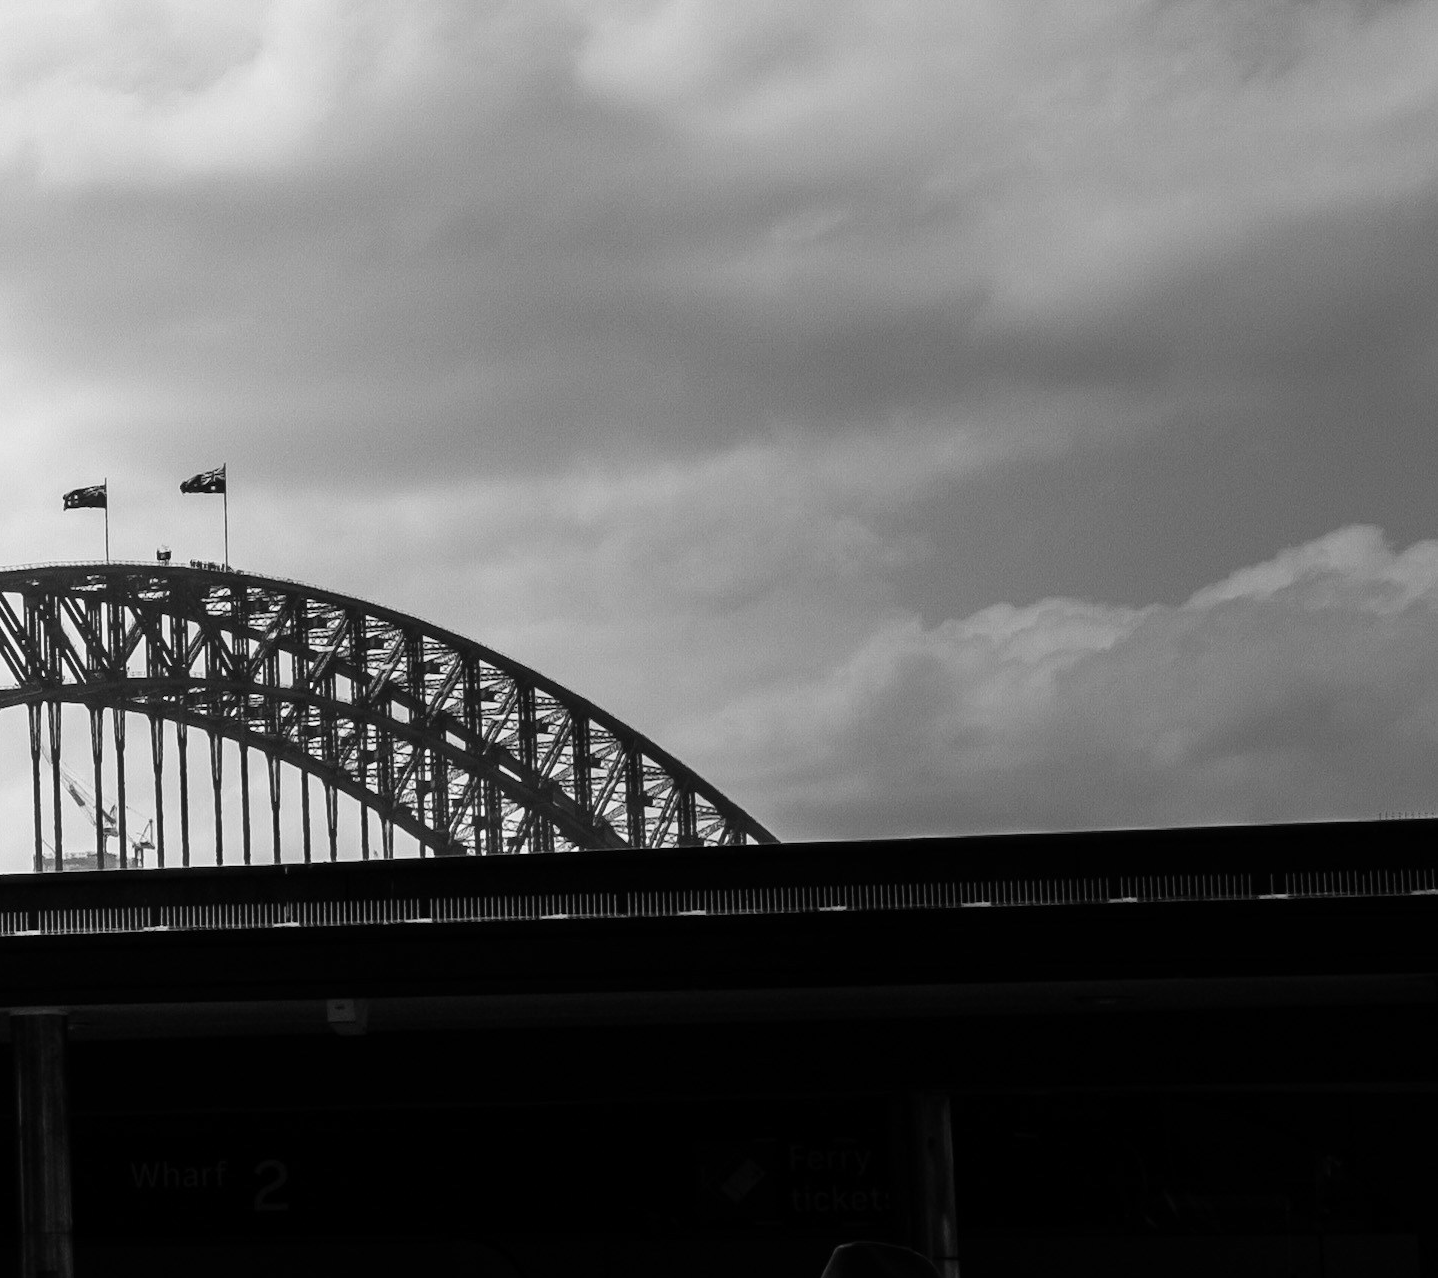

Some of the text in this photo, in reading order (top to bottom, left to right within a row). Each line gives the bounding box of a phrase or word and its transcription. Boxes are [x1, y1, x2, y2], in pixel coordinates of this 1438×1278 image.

[788, 1144, 873, 1177] Ferry
[130, 1159, 289, 1211] Wharf 2
